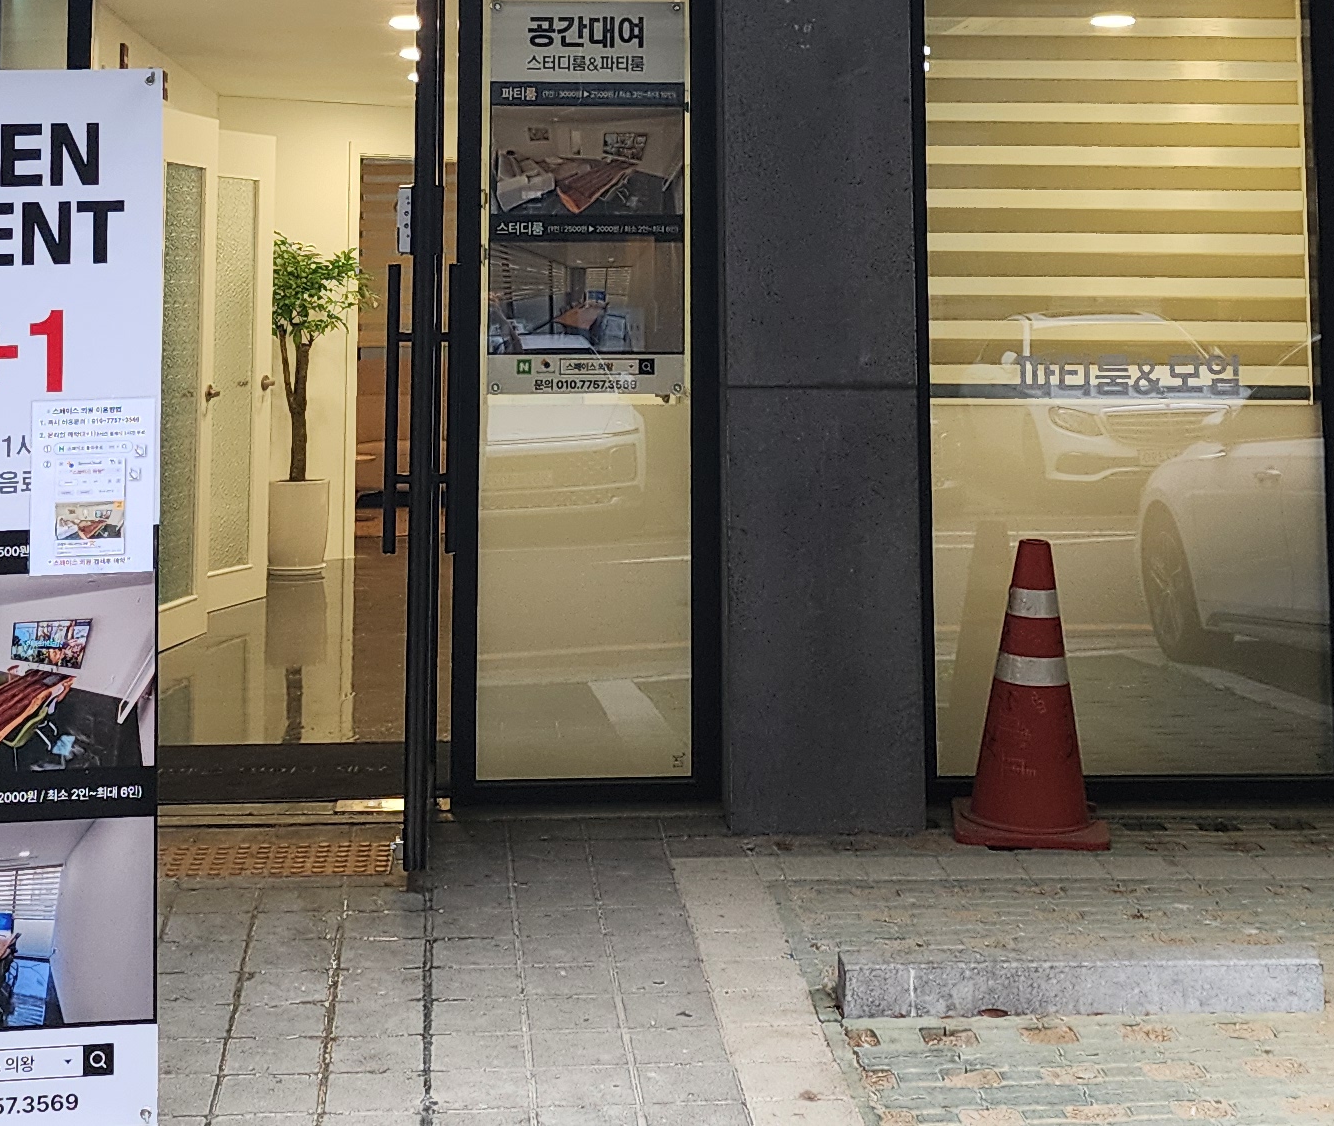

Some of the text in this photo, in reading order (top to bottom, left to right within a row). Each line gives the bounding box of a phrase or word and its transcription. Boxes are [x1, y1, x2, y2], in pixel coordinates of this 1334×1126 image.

[528, 16, 644, 48] 공간대여
[527, 55, 644, 72] 스터디룸&파티룸
[501, 86, 537, 100] 파티룸
[496, 222, 543, 235] 스터디룸
[1019, 354, 1240, 396] 파티룸&모임
[534, 379, 553, 390] 문의
[47, 788, 69, 802] 최소
[4, 1055, 35, 1074] 의왕
